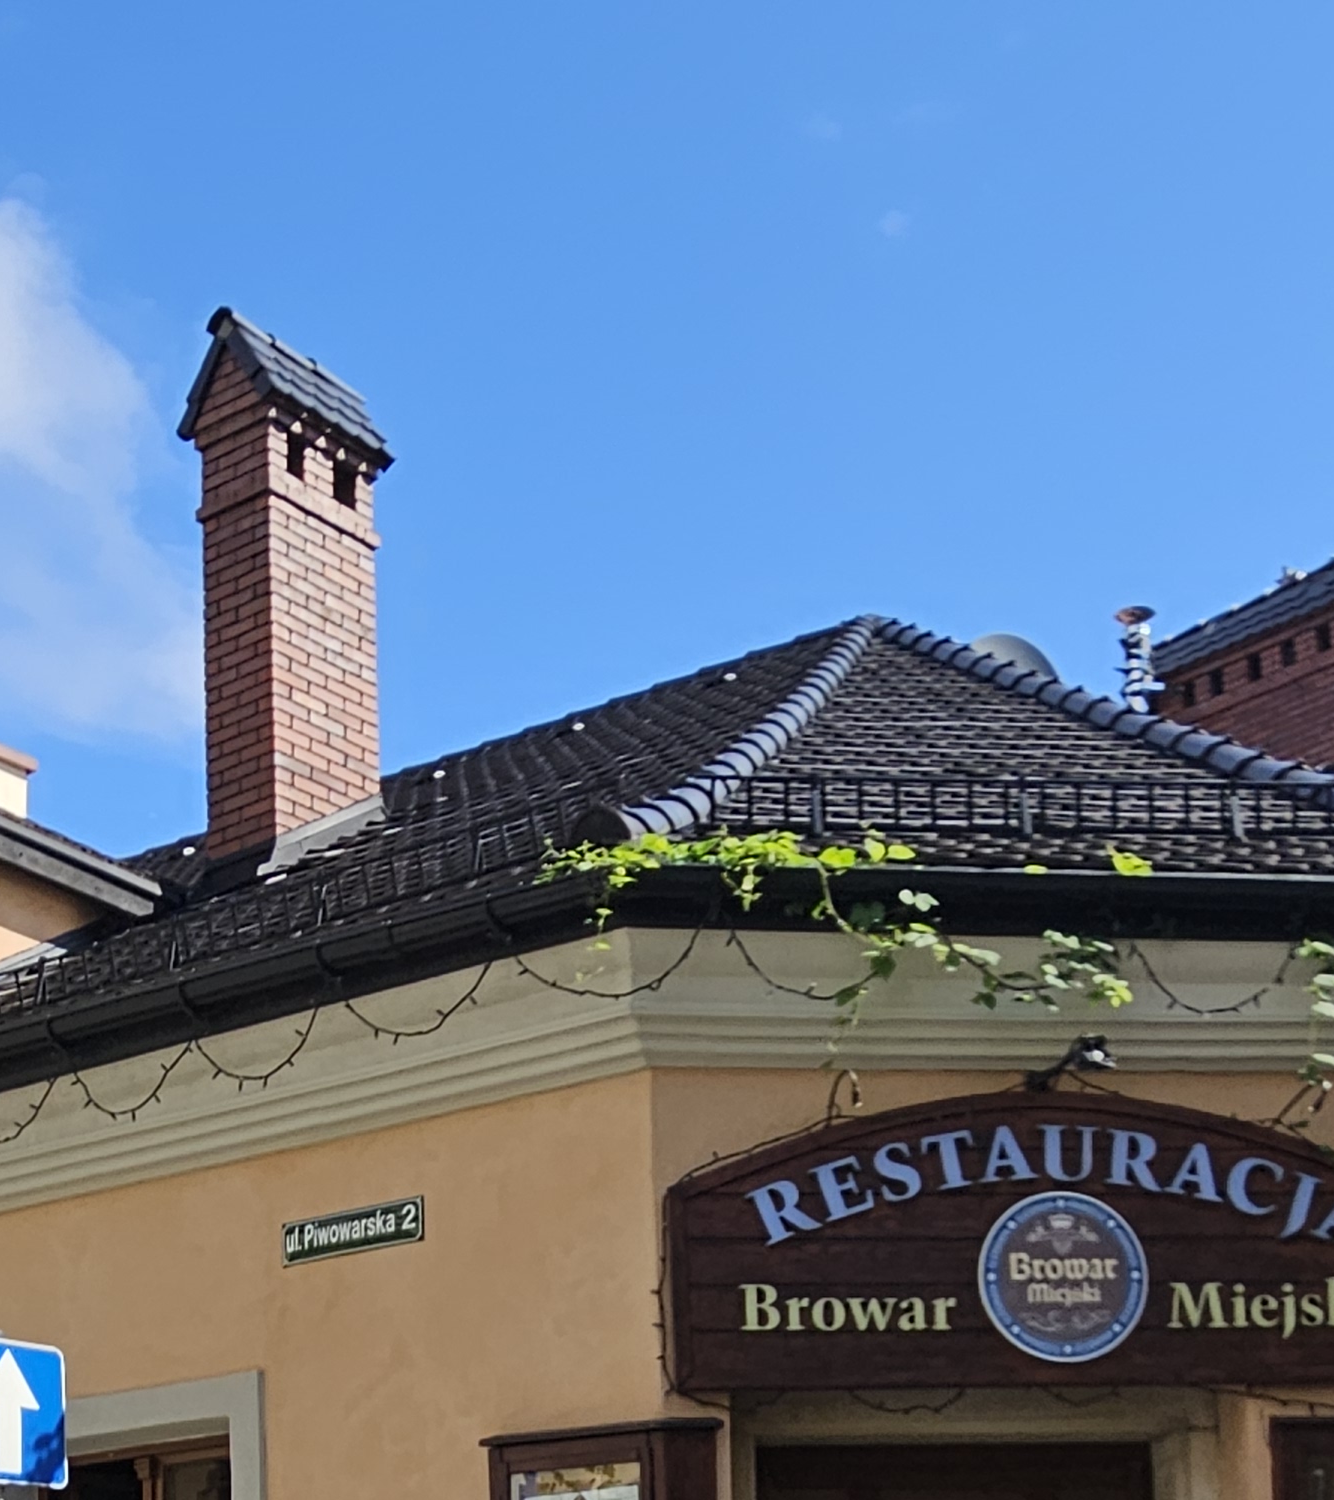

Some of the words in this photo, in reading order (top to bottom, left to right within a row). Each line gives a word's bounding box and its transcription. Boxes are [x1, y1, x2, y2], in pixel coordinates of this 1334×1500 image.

[304, 1209, 396, 1250] Piwowarska
[400, 1203, 417, 1231] 2
[1008, 1252, 1119, 1281] Browar
[738, 1283, 958, 1332] Browar
